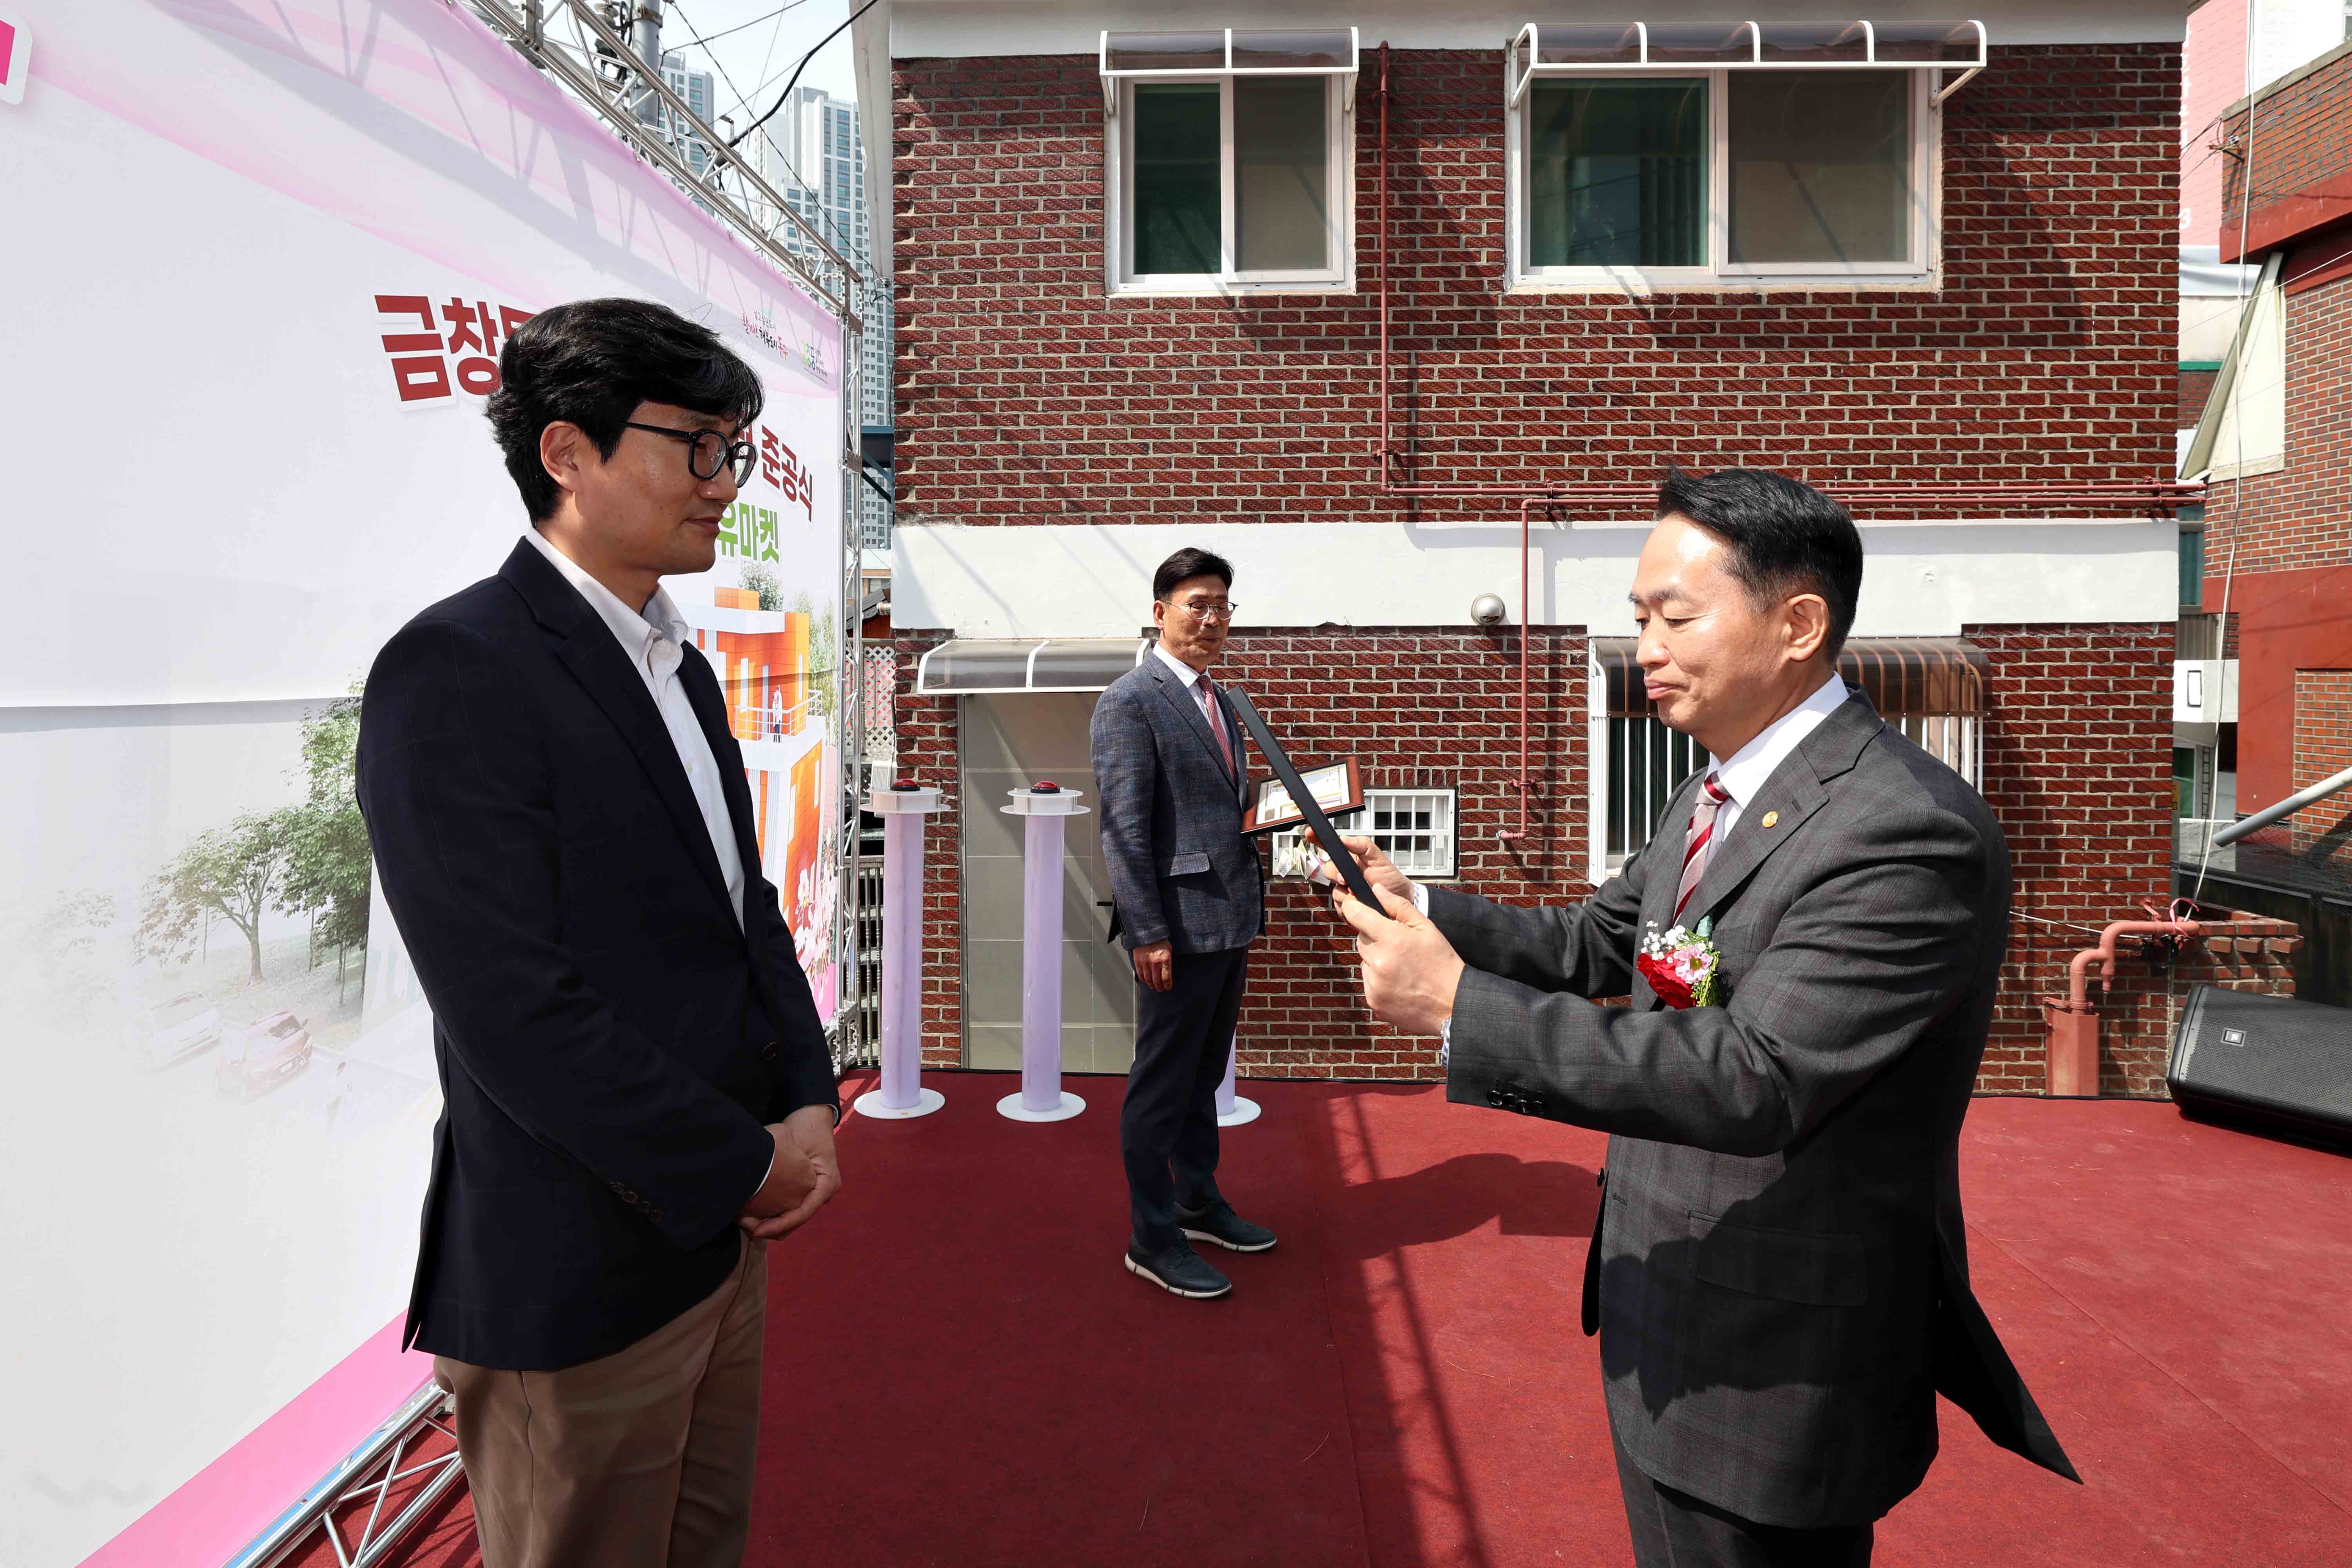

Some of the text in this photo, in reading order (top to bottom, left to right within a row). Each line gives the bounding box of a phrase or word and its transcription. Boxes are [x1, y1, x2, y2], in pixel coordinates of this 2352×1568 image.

[742, 313, 759, 338] 활기찬
[759, 326, 778, 351] 행복도시
[761, 424, 813, 523] 준공식
